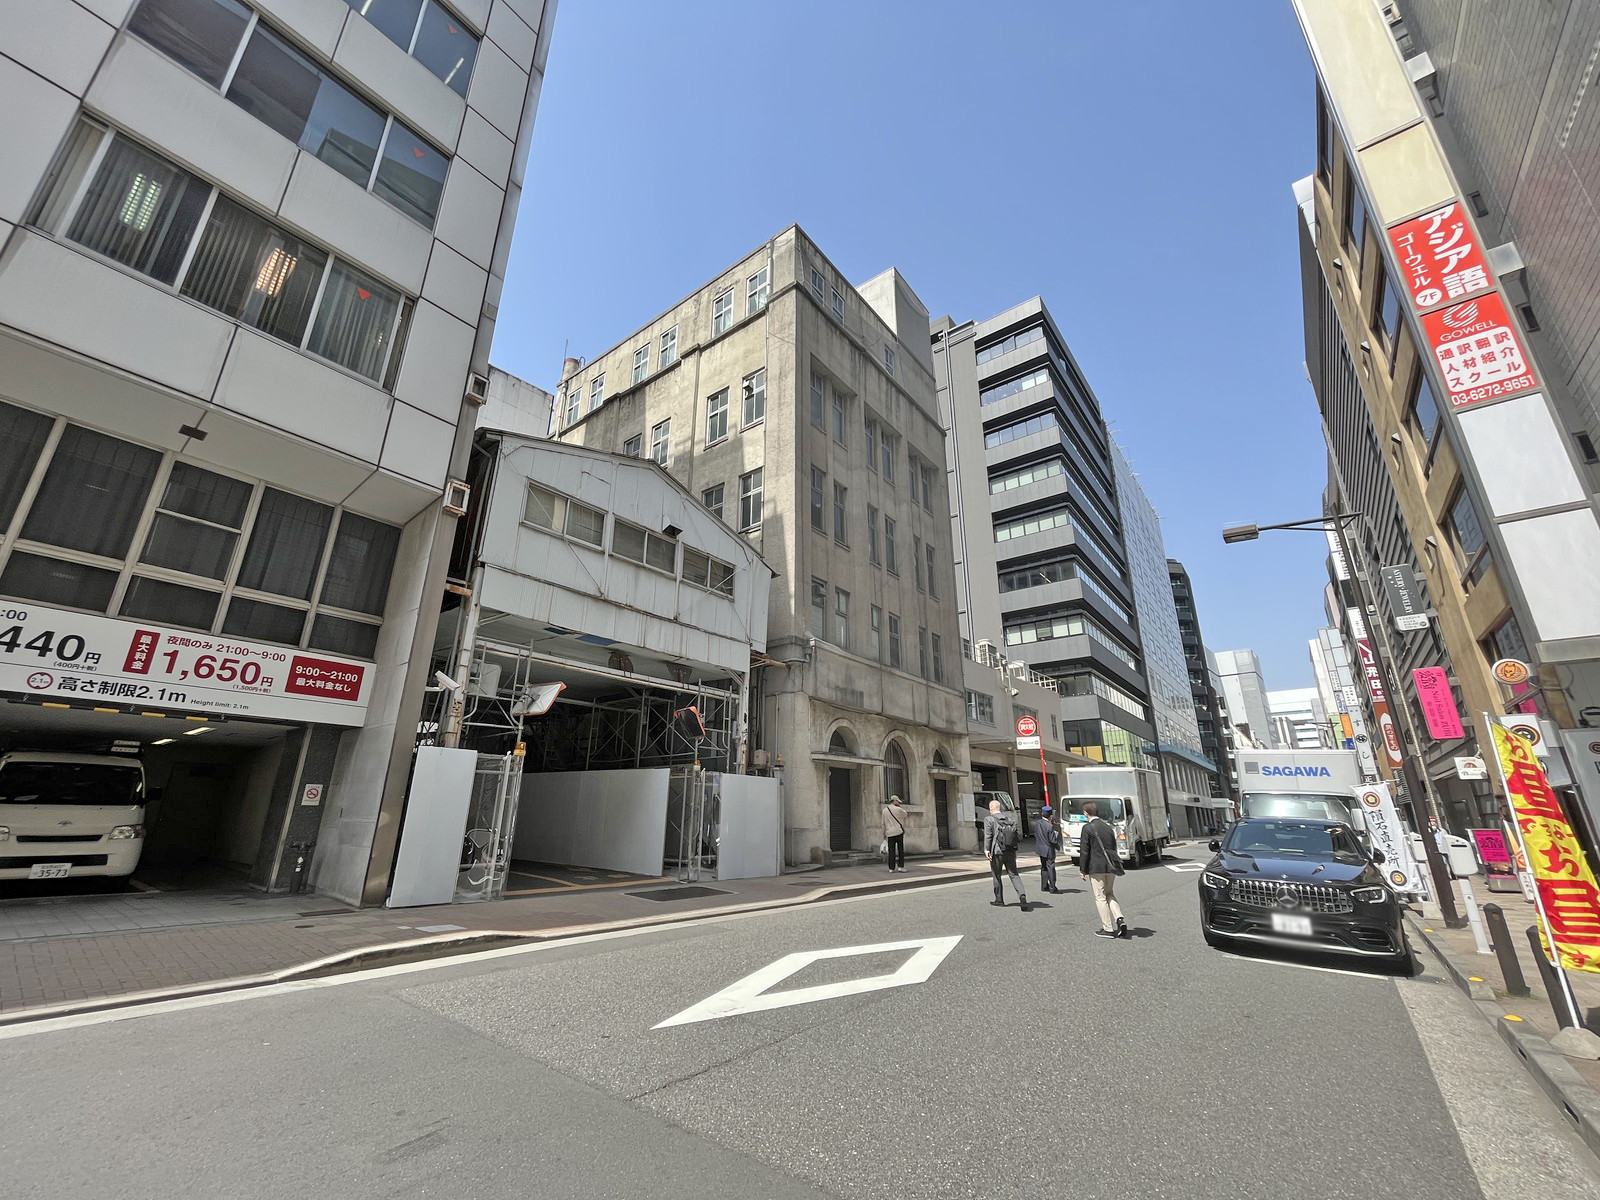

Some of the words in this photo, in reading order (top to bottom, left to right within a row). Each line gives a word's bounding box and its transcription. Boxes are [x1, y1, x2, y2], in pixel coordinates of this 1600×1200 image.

[1419, 203, 1489, 299] アジア語
[1420, 292, 1438, 304] 7F
[1440, 320, 1497, 342] GOWELL
[1439, 331, 1511, 361] 通訳翻訳
[1446, 346, 1516, 375] 人材紹介
[1450, 361, 1522, 388] スクール
[1451, 376, 1536, 406] 03-6272-9651
[131, 634, 153, 670] 最大料金
[167, 635, 213, 649] 夜間のみ
[295, 677, 352, 692] 最大料金なし
[190, 698, 214, 708] Height
[1261, 765, 1331, 777] SAGAWA
[37, 869, 68, 878] 35-73
